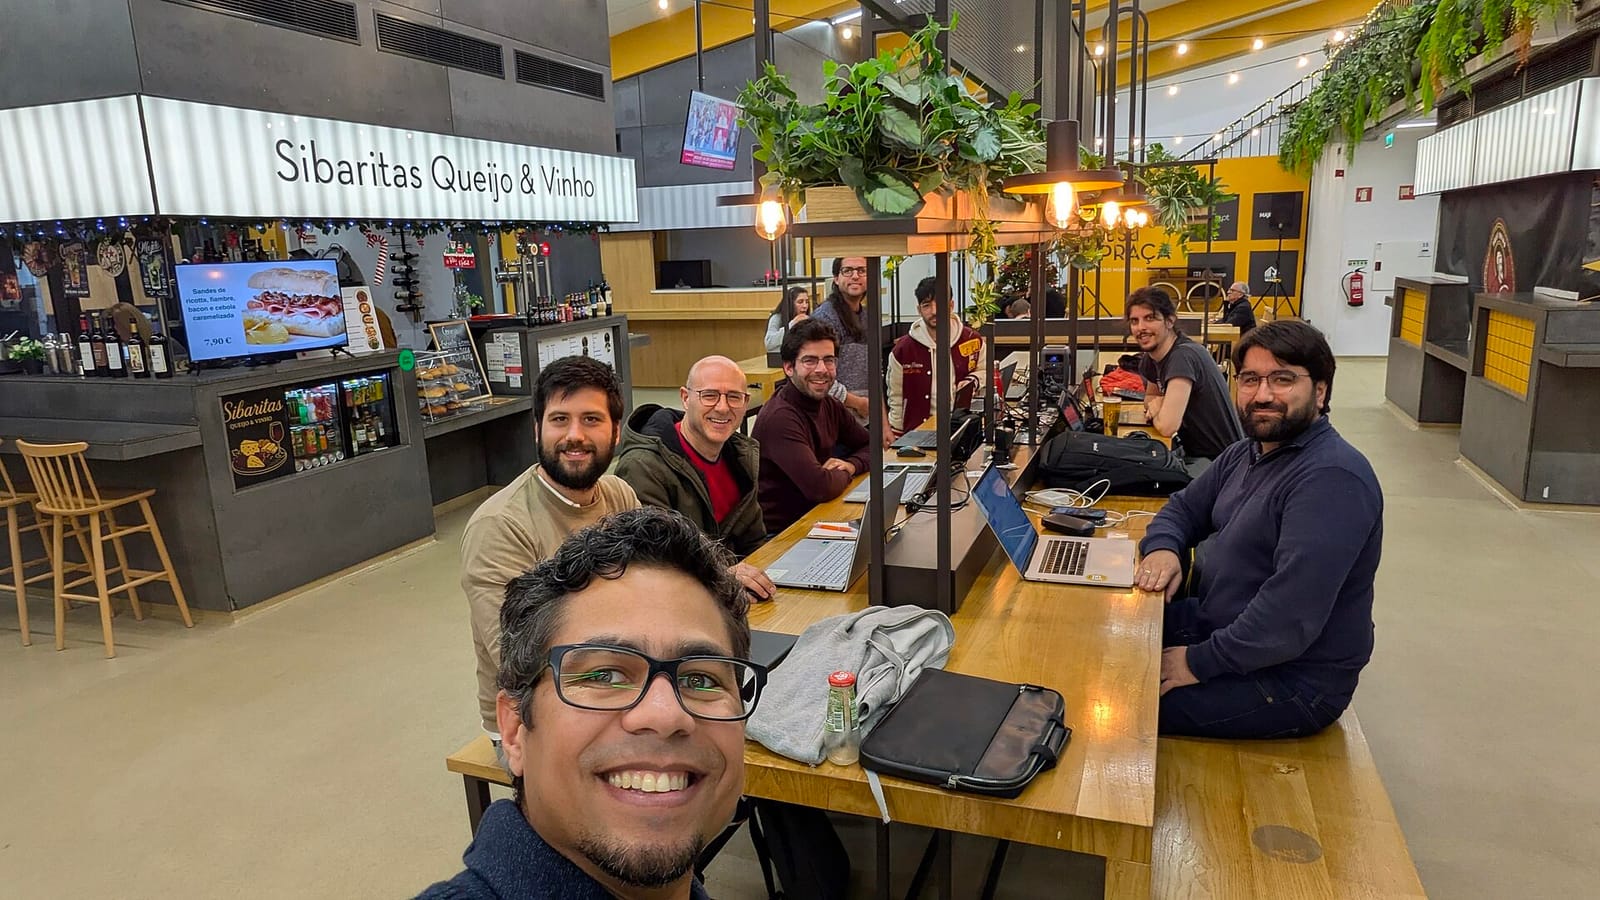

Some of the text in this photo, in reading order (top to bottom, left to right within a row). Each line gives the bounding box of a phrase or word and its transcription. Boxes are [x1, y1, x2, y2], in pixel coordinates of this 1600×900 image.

[275, 139, 595, 203] Sibaritas Queijo & Vinho
[192, 313, 235, 321] caramelizada
[204, 338, 223, 346] 7,90
[224, 398, 283, 423] Sibaritas
[229, 420, 250, 430] QUEIJO
[254, 416, 273, 424] VINHO
